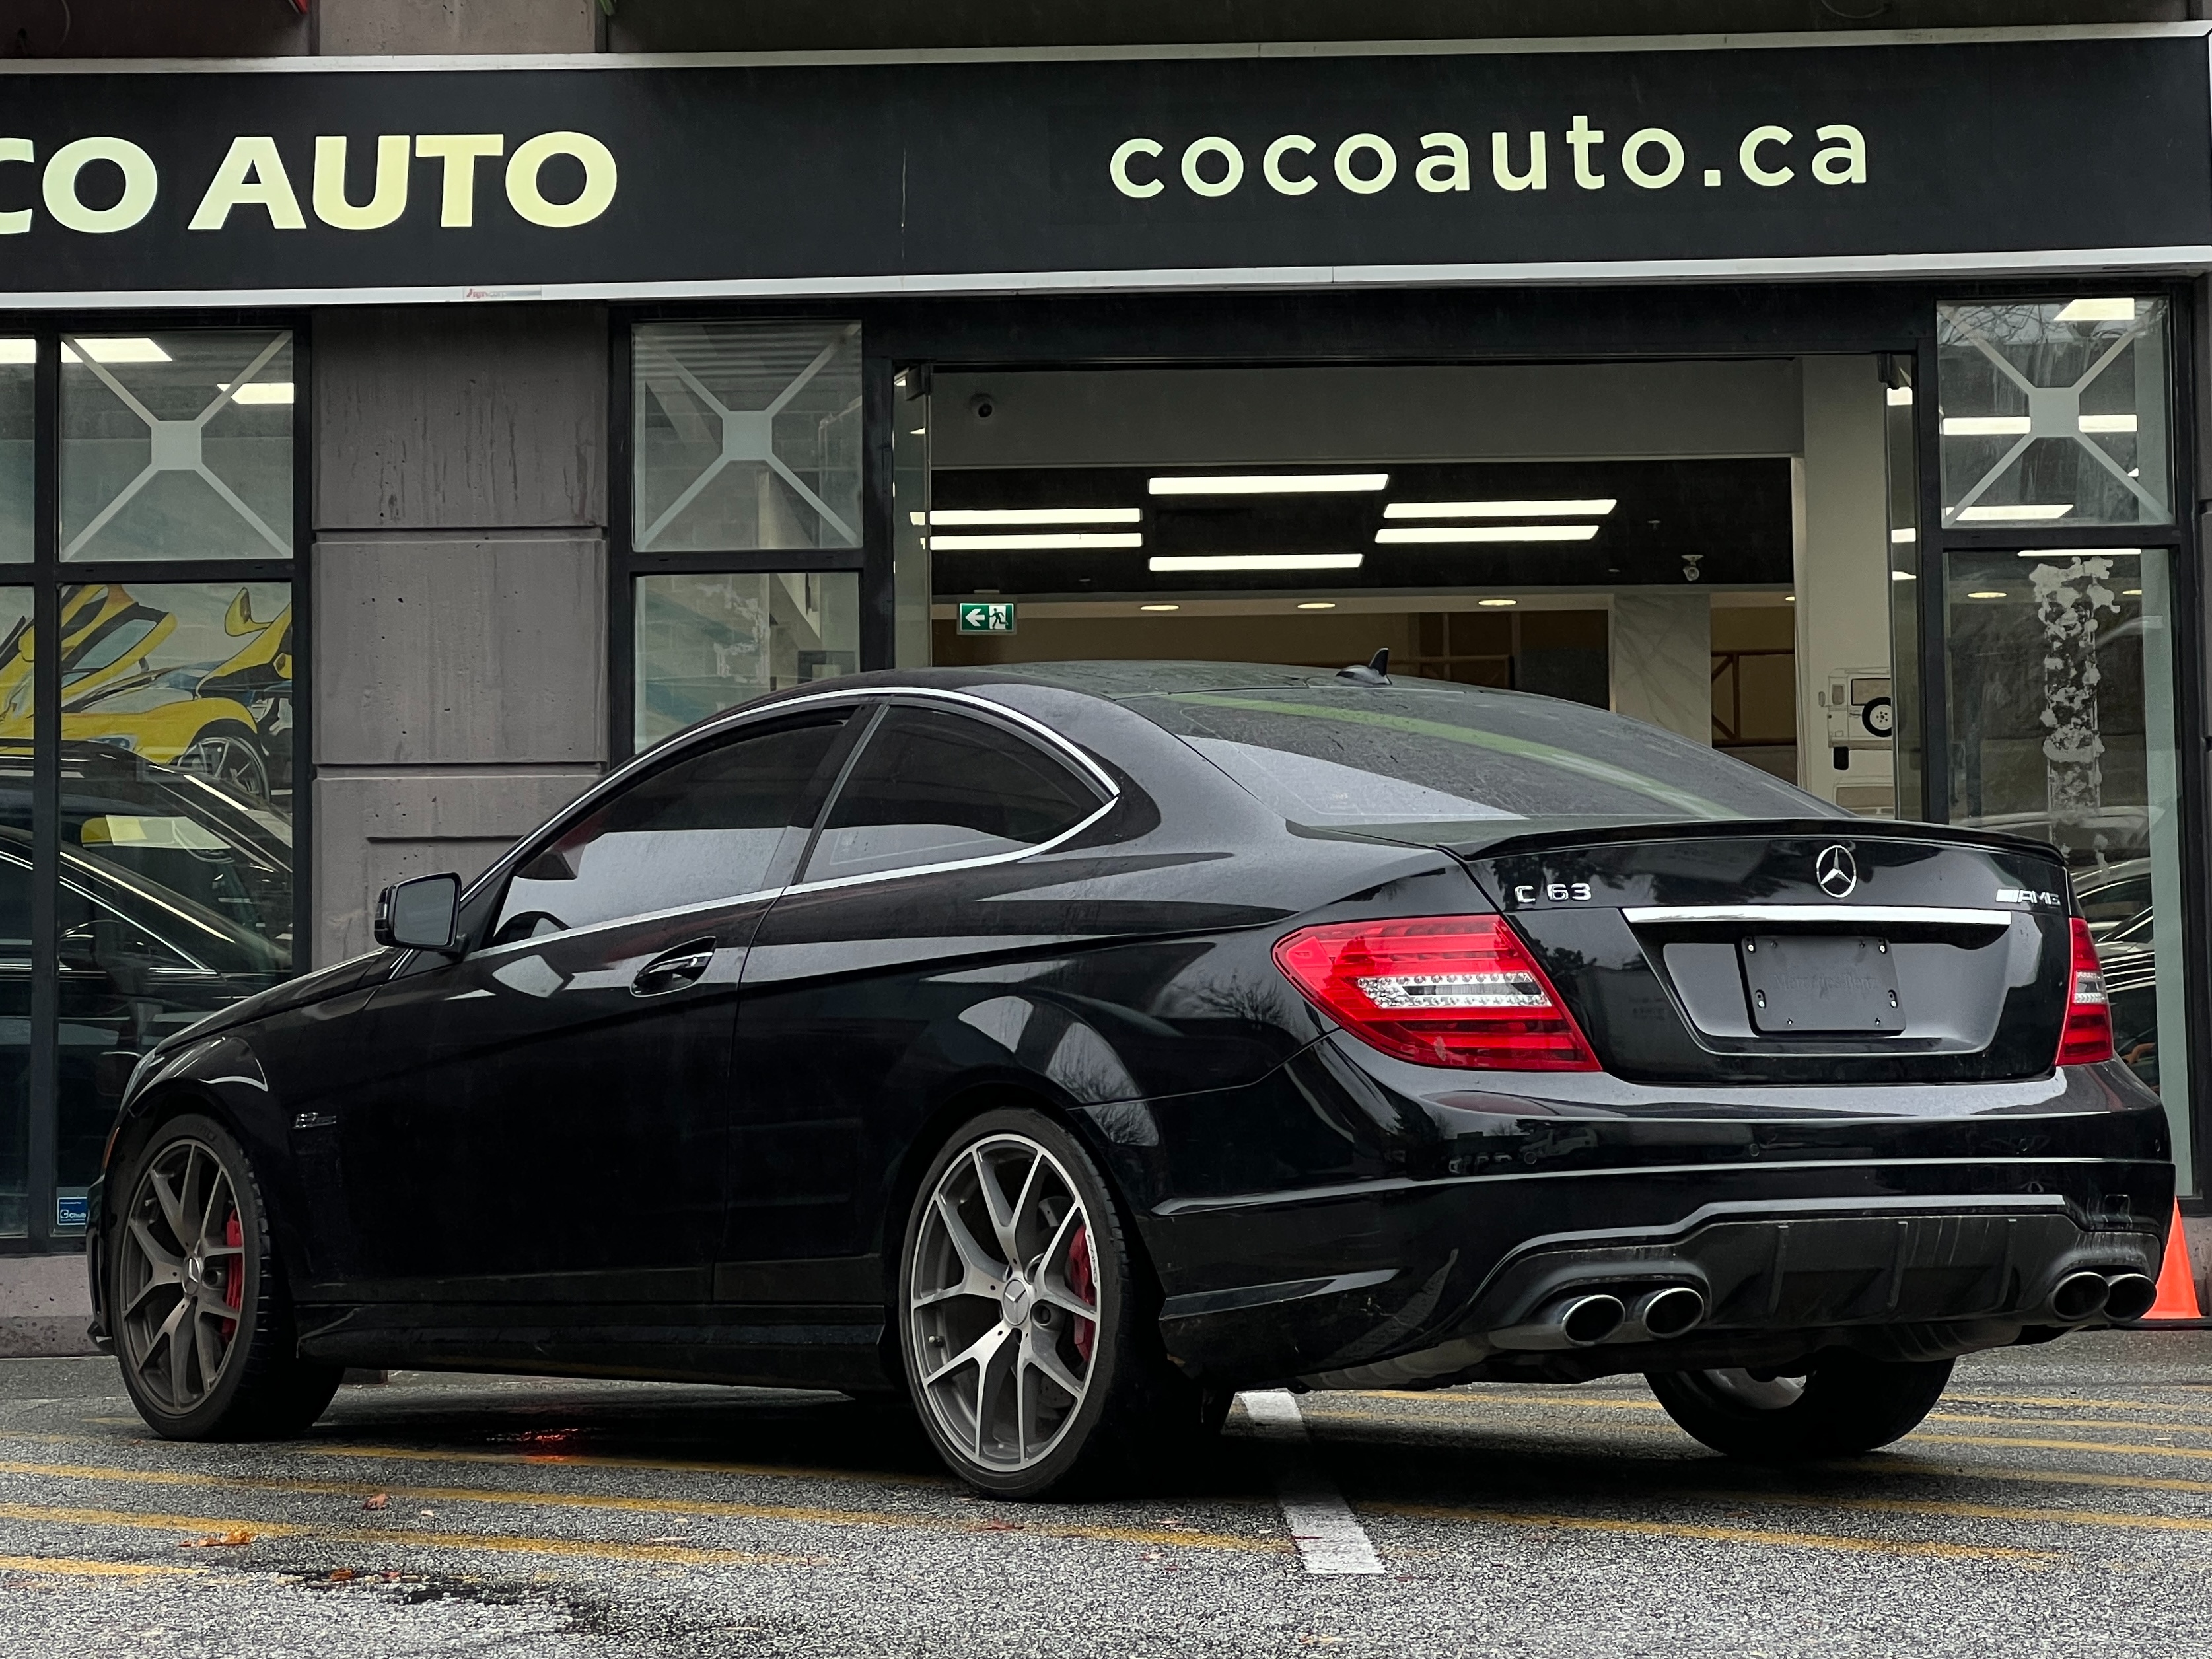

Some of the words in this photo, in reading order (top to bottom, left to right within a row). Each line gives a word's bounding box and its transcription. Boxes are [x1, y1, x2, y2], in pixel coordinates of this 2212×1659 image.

[188, 131, 617, 230] AUTO
[1110, 116, 1867, 197] cocoauto.ca
[1515, 885, 1536, 903] C
[1547, 883, 1592, 901] 63
[2018, 890, 2061, 905] AMG
